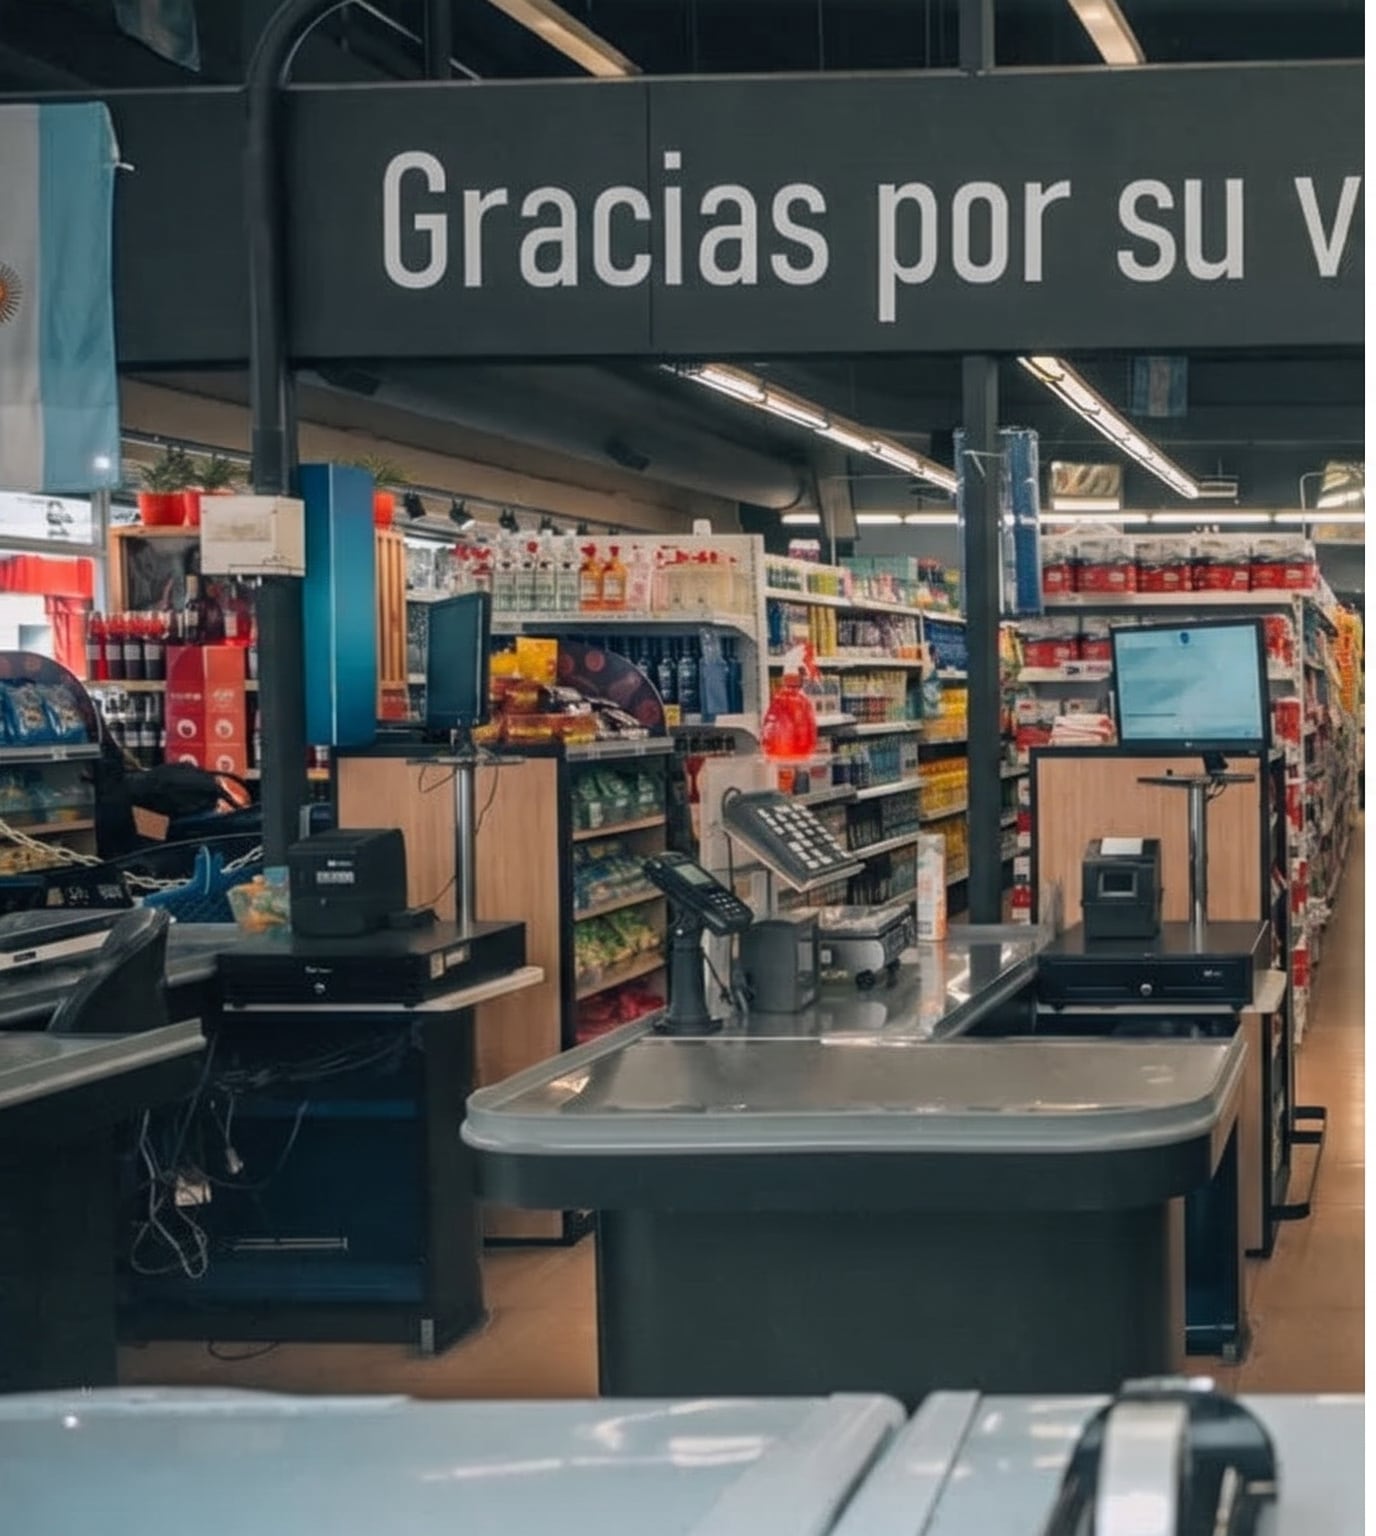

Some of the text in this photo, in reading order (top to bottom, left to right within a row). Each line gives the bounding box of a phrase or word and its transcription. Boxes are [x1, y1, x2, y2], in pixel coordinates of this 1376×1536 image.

[383, 150, 829, 289] Gracias
[878, 179, 1071, 323] por
[1117, 178, 1244, 282] su
